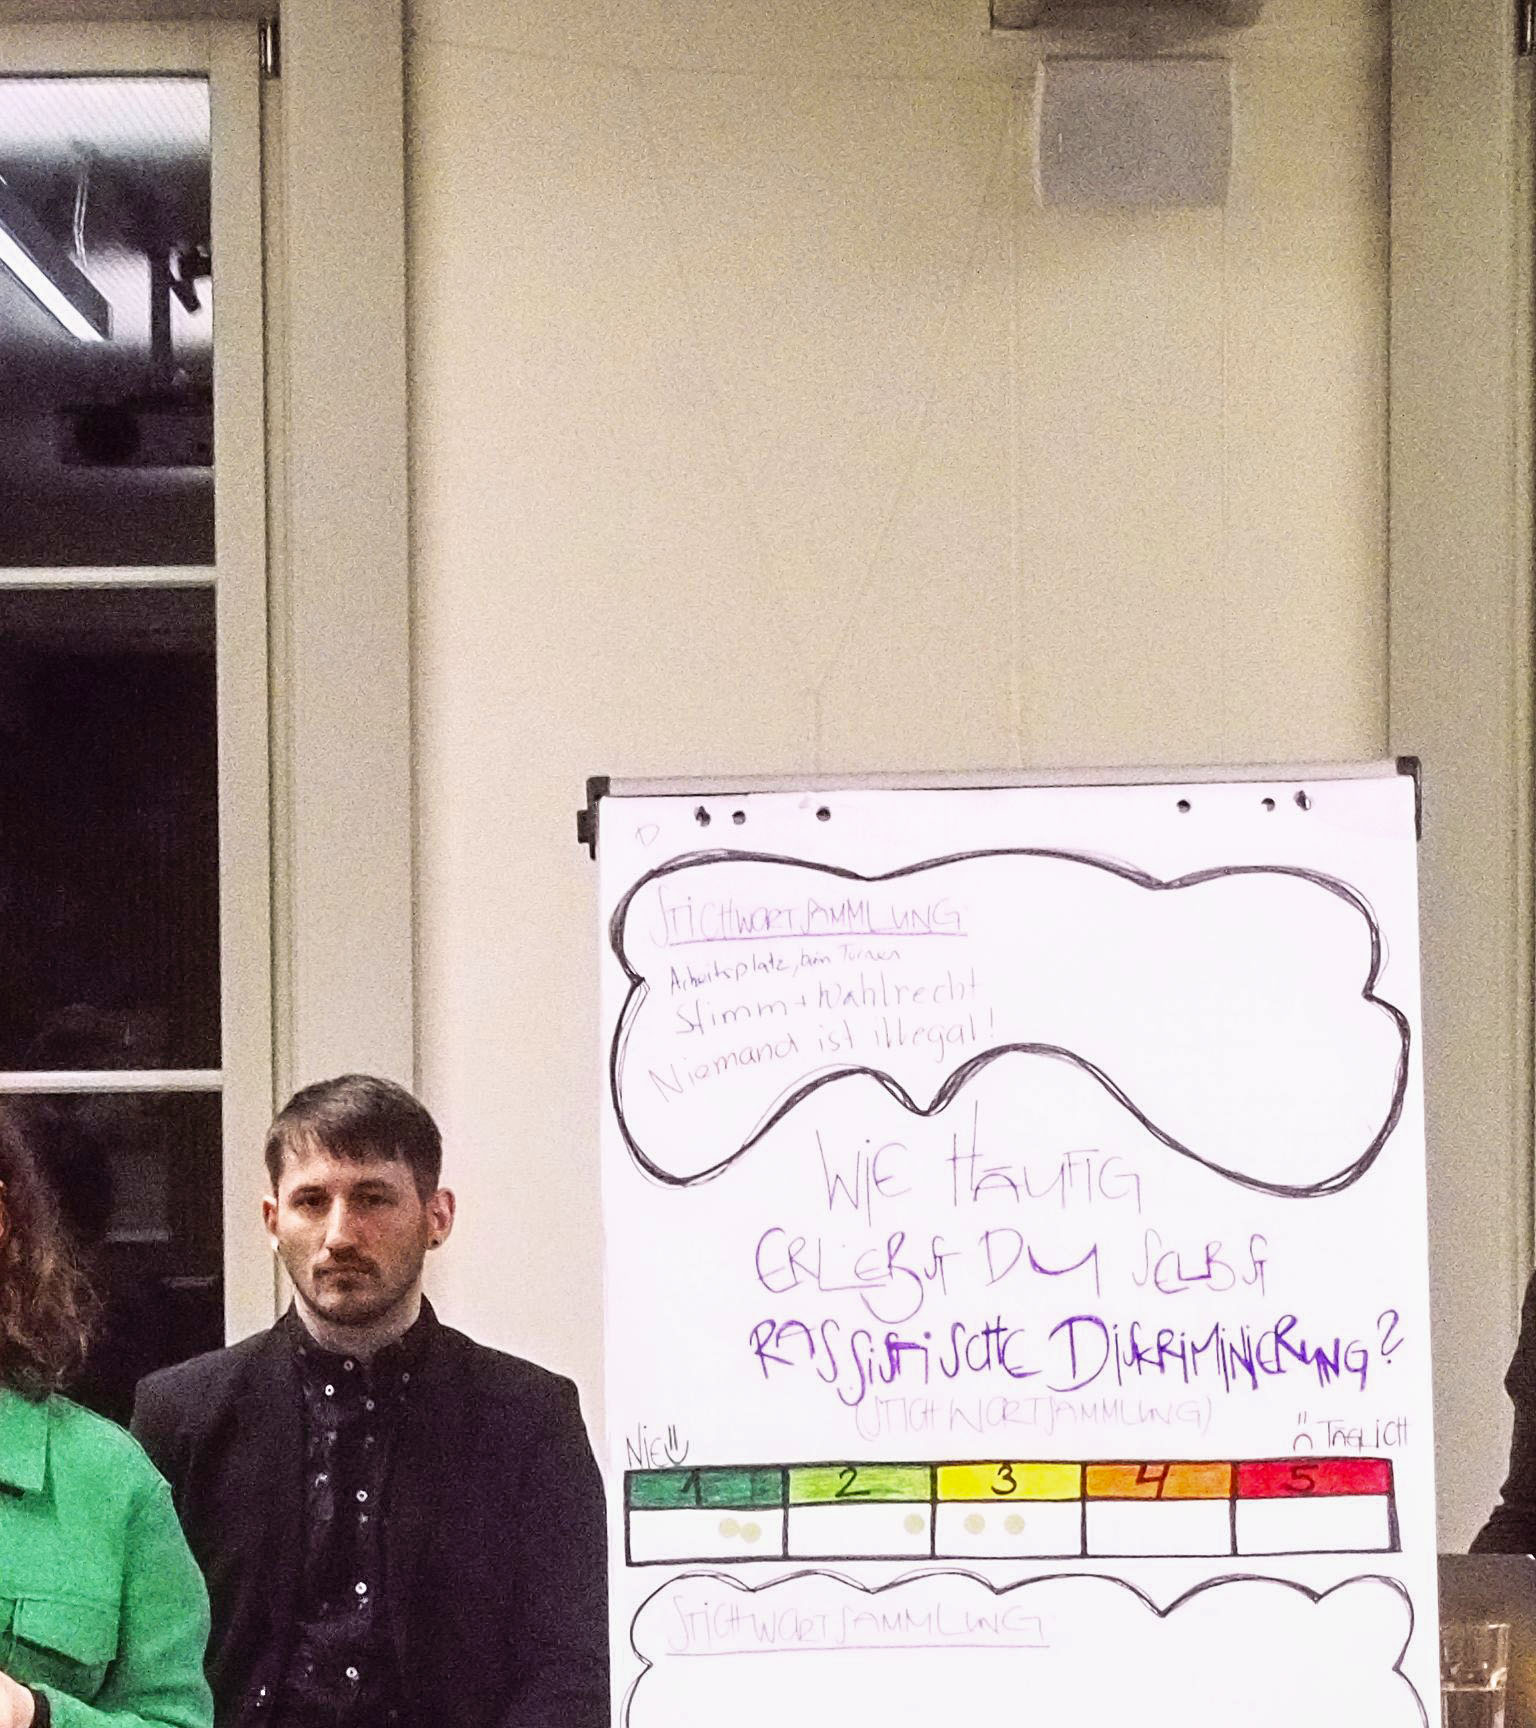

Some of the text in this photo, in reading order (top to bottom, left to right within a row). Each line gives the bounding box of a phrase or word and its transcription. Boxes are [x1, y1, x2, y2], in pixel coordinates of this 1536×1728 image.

[648, 1033, 799, 1103] Niemand
[818, 1018, 856, 1053] ist
[835, 1464, 872, 1499] 2
[990, 1461, 1018, 1496] 3
[1135, 1463, 1168, 1499] 4
[1285, 1464, 1319, 1492] 5
